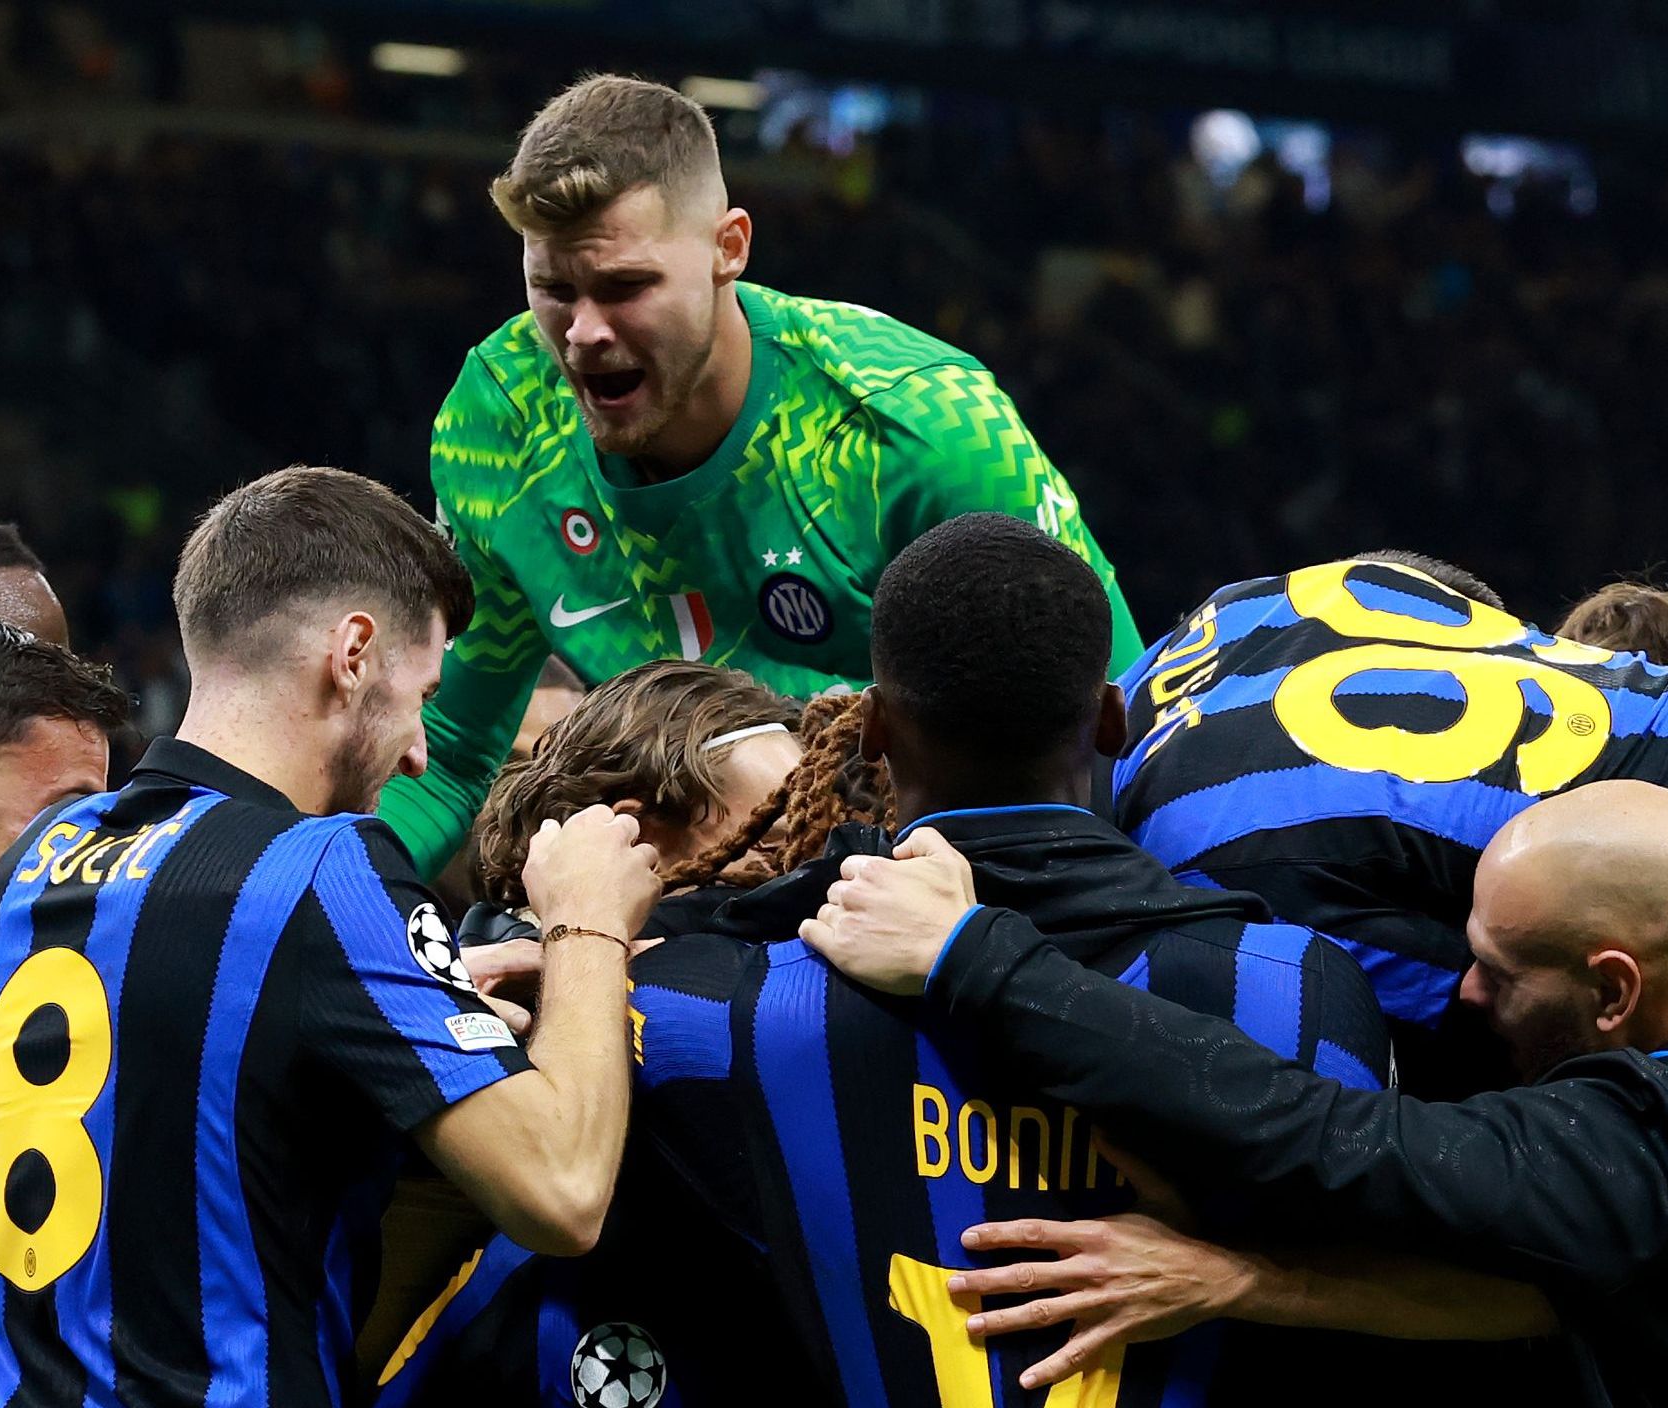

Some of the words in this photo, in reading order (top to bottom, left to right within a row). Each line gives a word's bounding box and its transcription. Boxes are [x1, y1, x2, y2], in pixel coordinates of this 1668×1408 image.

[450, 1016, 477, 1027] UEFA
[454, 1023, 514, 1038] FOUN
[912, 1082, 1129, 1192] BONN
